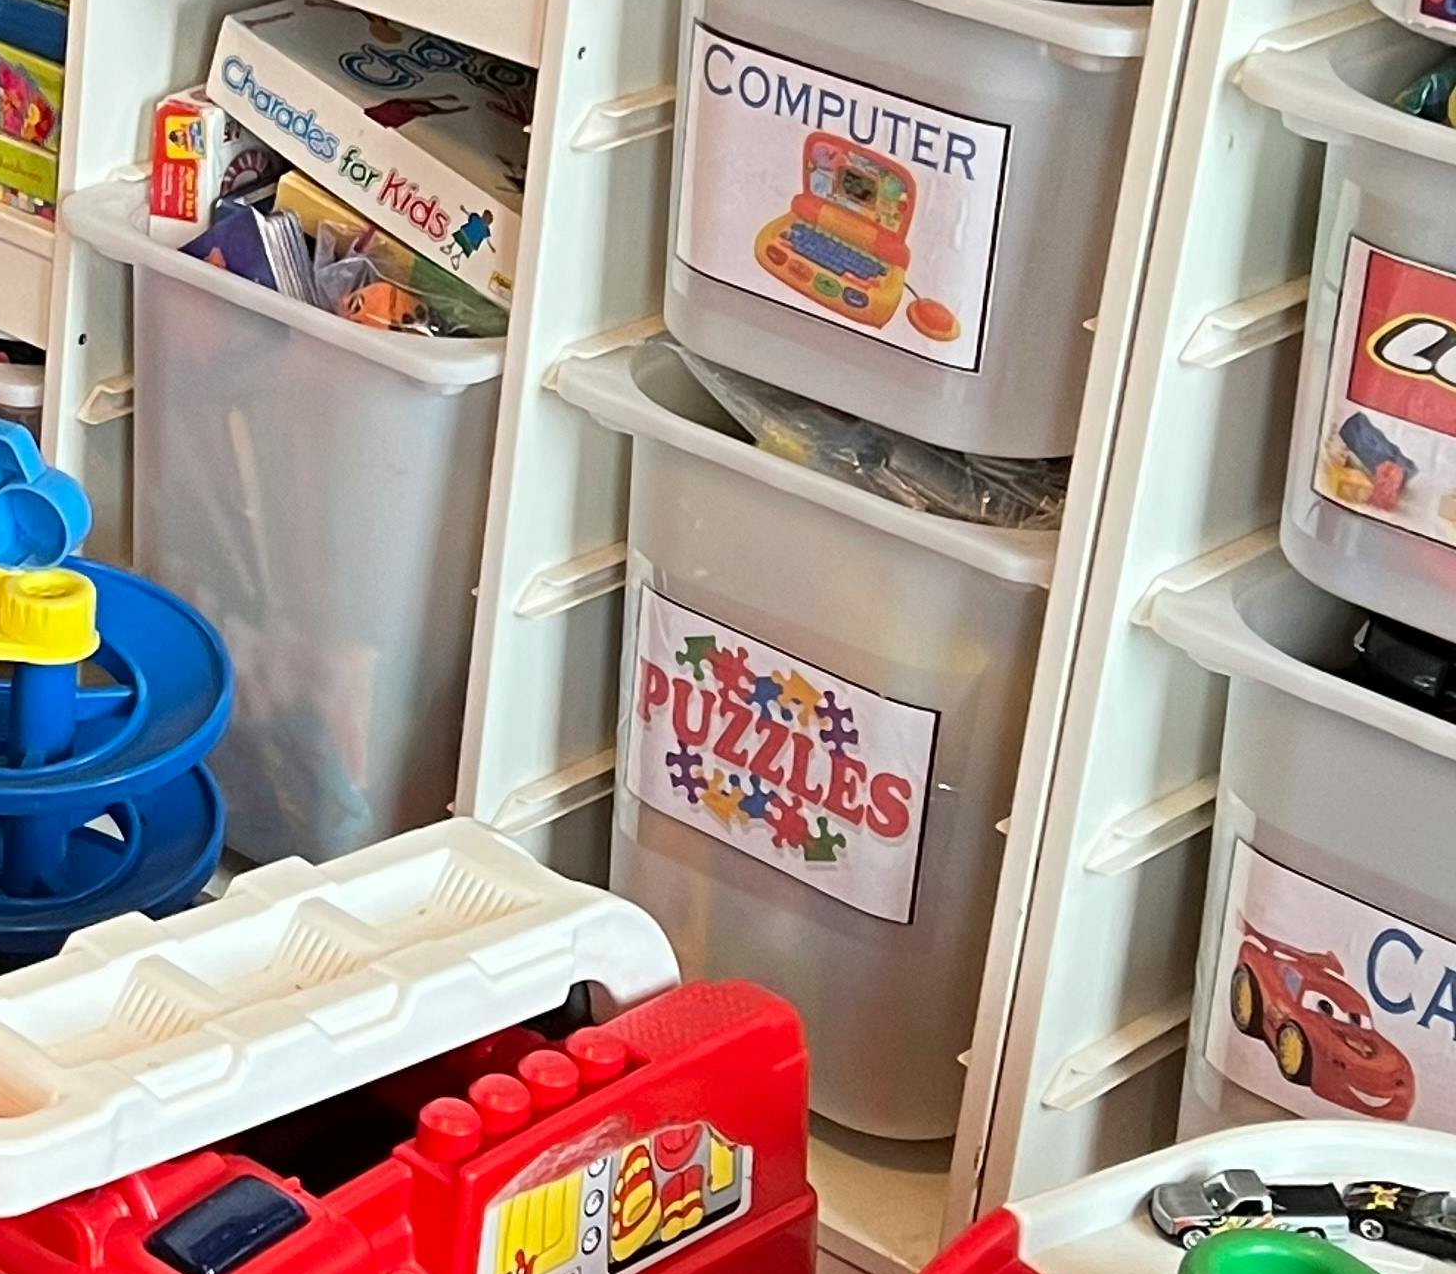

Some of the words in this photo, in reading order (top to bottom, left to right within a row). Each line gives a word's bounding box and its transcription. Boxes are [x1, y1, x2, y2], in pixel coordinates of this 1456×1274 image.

[221, 55, 340, 163] Charades
[339, 147, 380, 191] for
[377, 168, 450, 242] Kids
[703, 43, 977, 181] COMPUTER
[638, 656, 913, 840] PUZZLES
